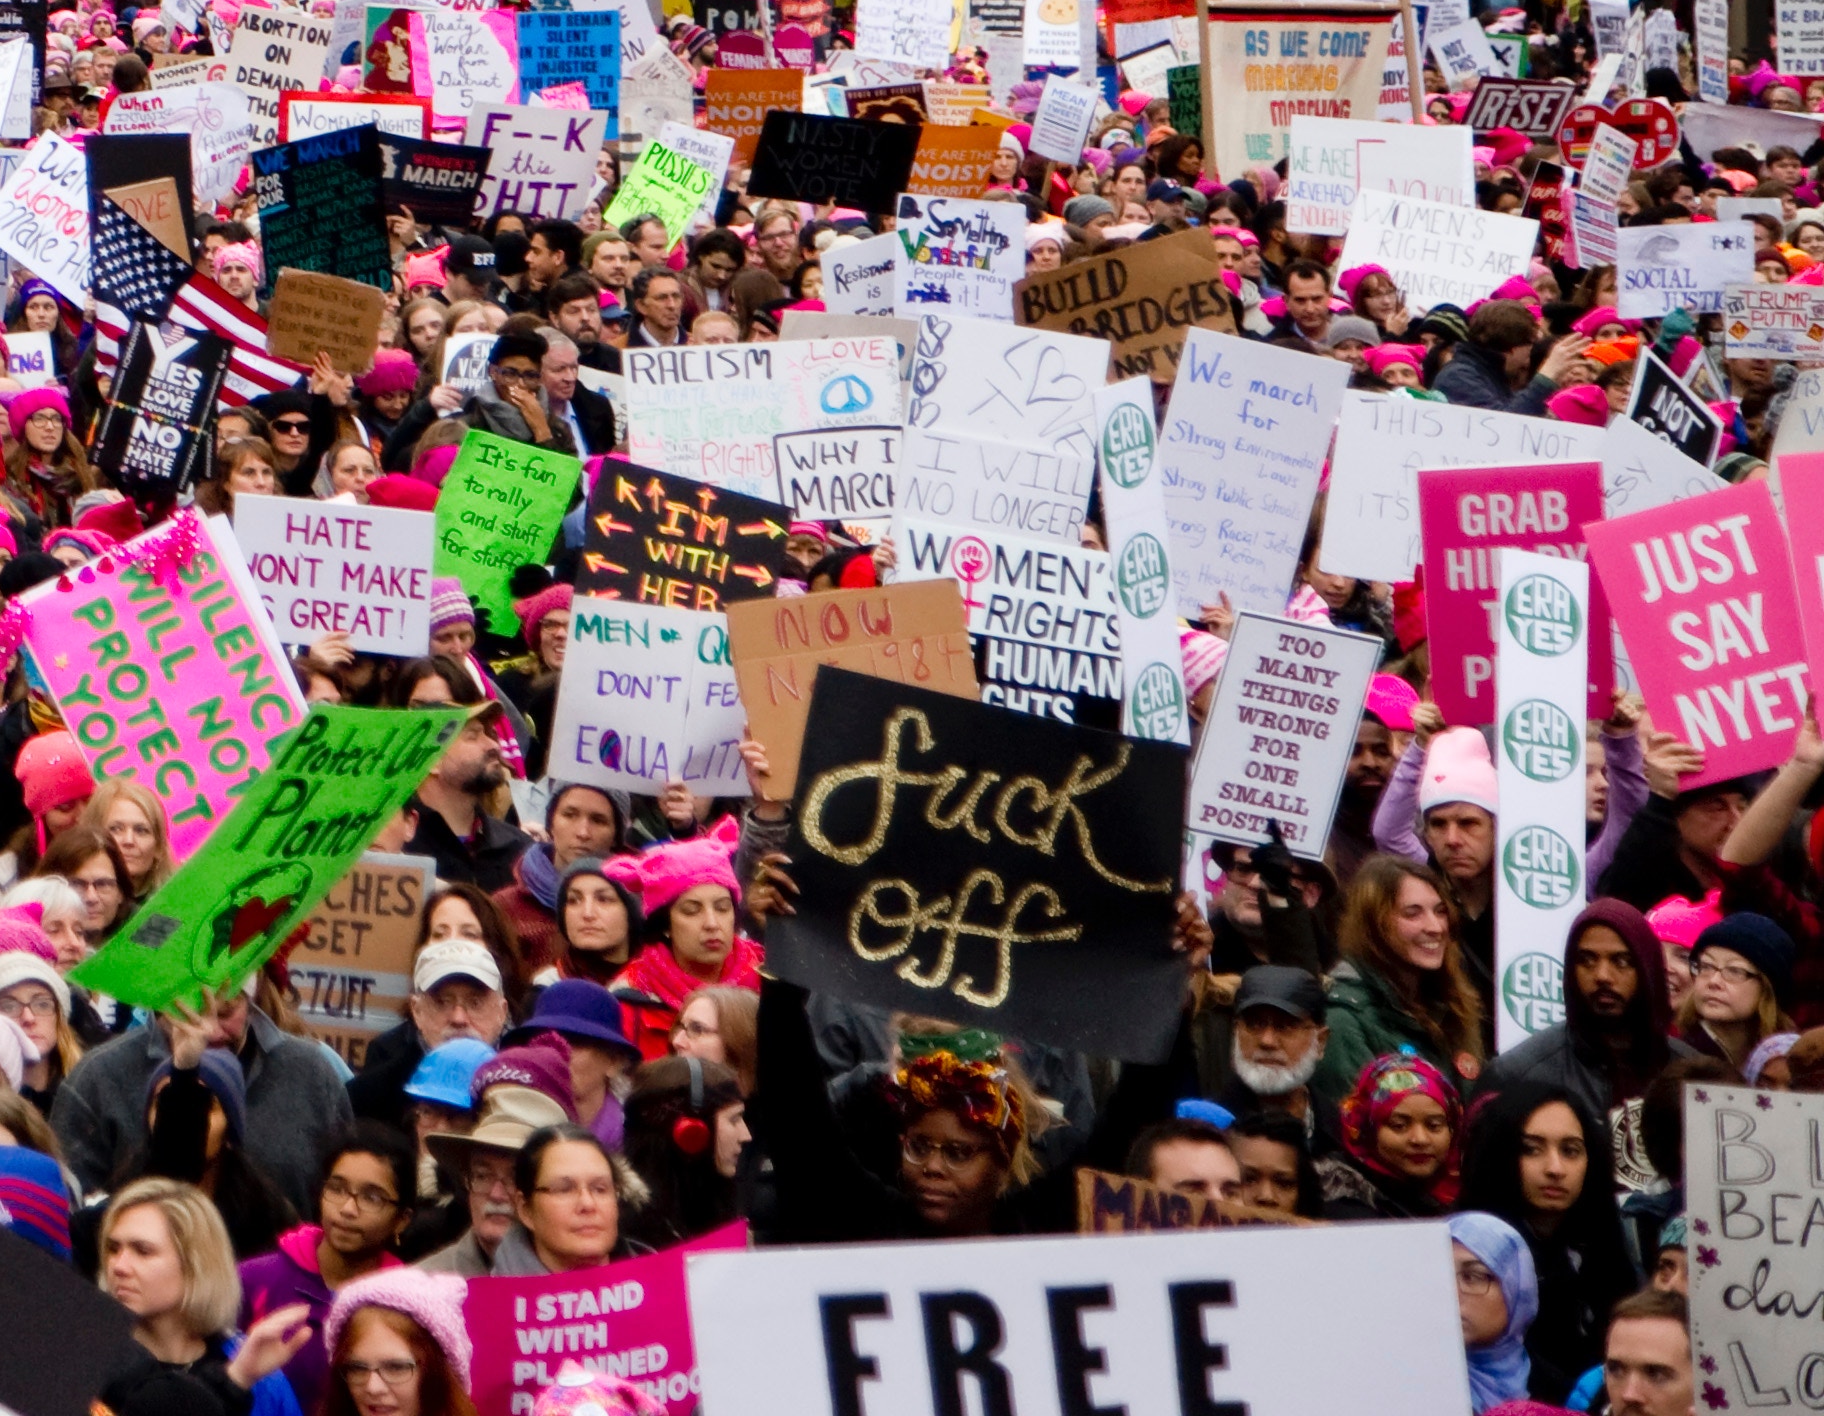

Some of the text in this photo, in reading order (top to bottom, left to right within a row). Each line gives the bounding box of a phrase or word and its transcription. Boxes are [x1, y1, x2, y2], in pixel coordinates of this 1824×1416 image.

[404, 167, 478, 188] MARCH
[286, 515, 372, 550] HATE
[1631, 515, 1758, 603] JUST
[341, 564, 425, 599] MAKE
[290, 600, 407, 639] GREAT!
[1671, 593, 1770, 672] SAY
[1278, 634, 1326, 659] TOO
[1257, 656, 1340, 687] MANY
[1241, 679, 1340, 715] THINGS
[1675, 665, 1810, 752] NYET
[1238, 706, 1329, 740] WRONG
[1252, 735, 1300, 761] FOR
[1244, 762, 1298, 787] ONE
[1219, 784, 1308, 815] SMALL
[818, 1280, 1250, 1416] FREE
